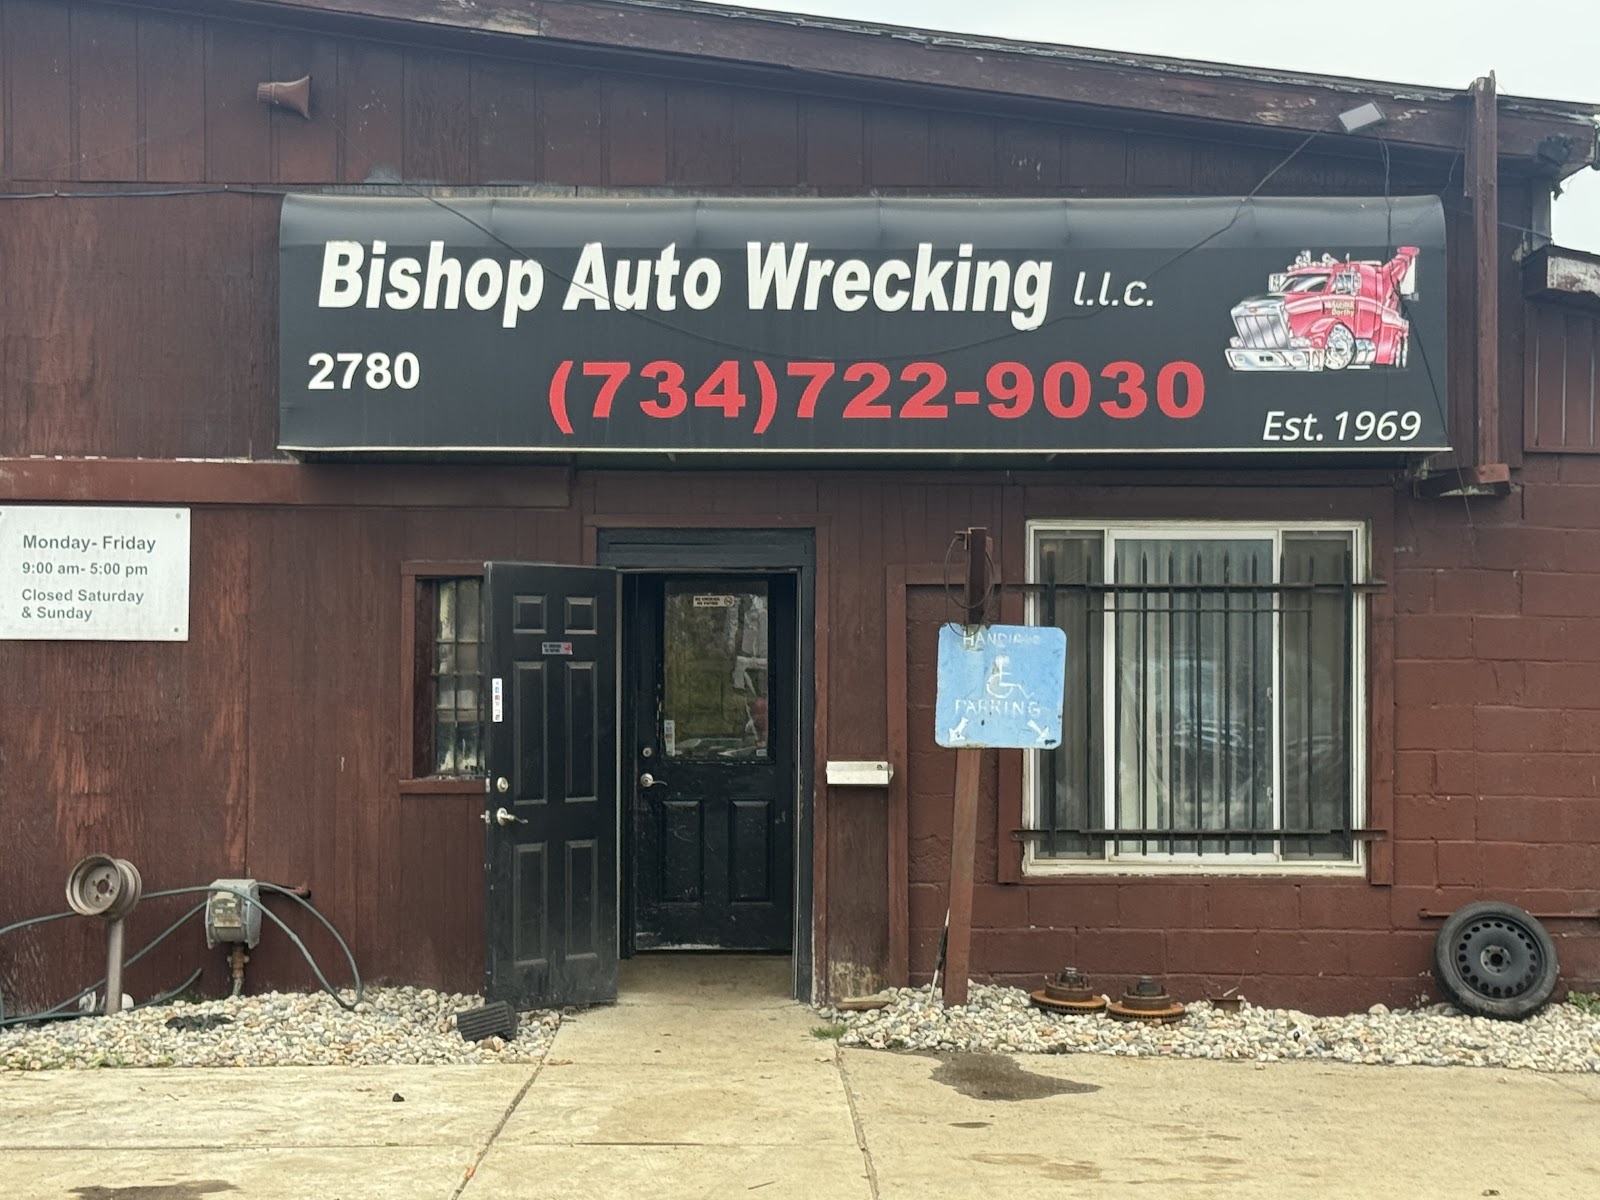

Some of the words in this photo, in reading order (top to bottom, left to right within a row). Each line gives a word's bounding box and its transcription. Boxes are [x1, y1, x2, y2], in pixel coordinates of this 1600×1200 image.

[319, 240, 544, 328] Bishop
[562, 242, 722, 312] Auto
[746, 242, 1053, 331] Wrecking
[1073, 271, 1154, 307] l.l.c.
[307, 352, 420, 390] 2780
[549, 360, 1205, 434] (734)722-9030
[1262, 410, 1324, 441] Est.
[1335, 410, 1422, 441] 1969
[23, 534, 98, 552] Monday-
[102, 535, 156, 553] Friday
[22, 561, 53, 575] 9:00
[57, 564, 86, 575] am-
[90, 562, 121, 575] 5:00
[125, 565, 148, 578] pm
[22, 588, 73, 601] Closed
[78, 589, 144, 605] Saturday
[21, 606, 32, 619] &
[36, 606, 92, 622] Sunday
